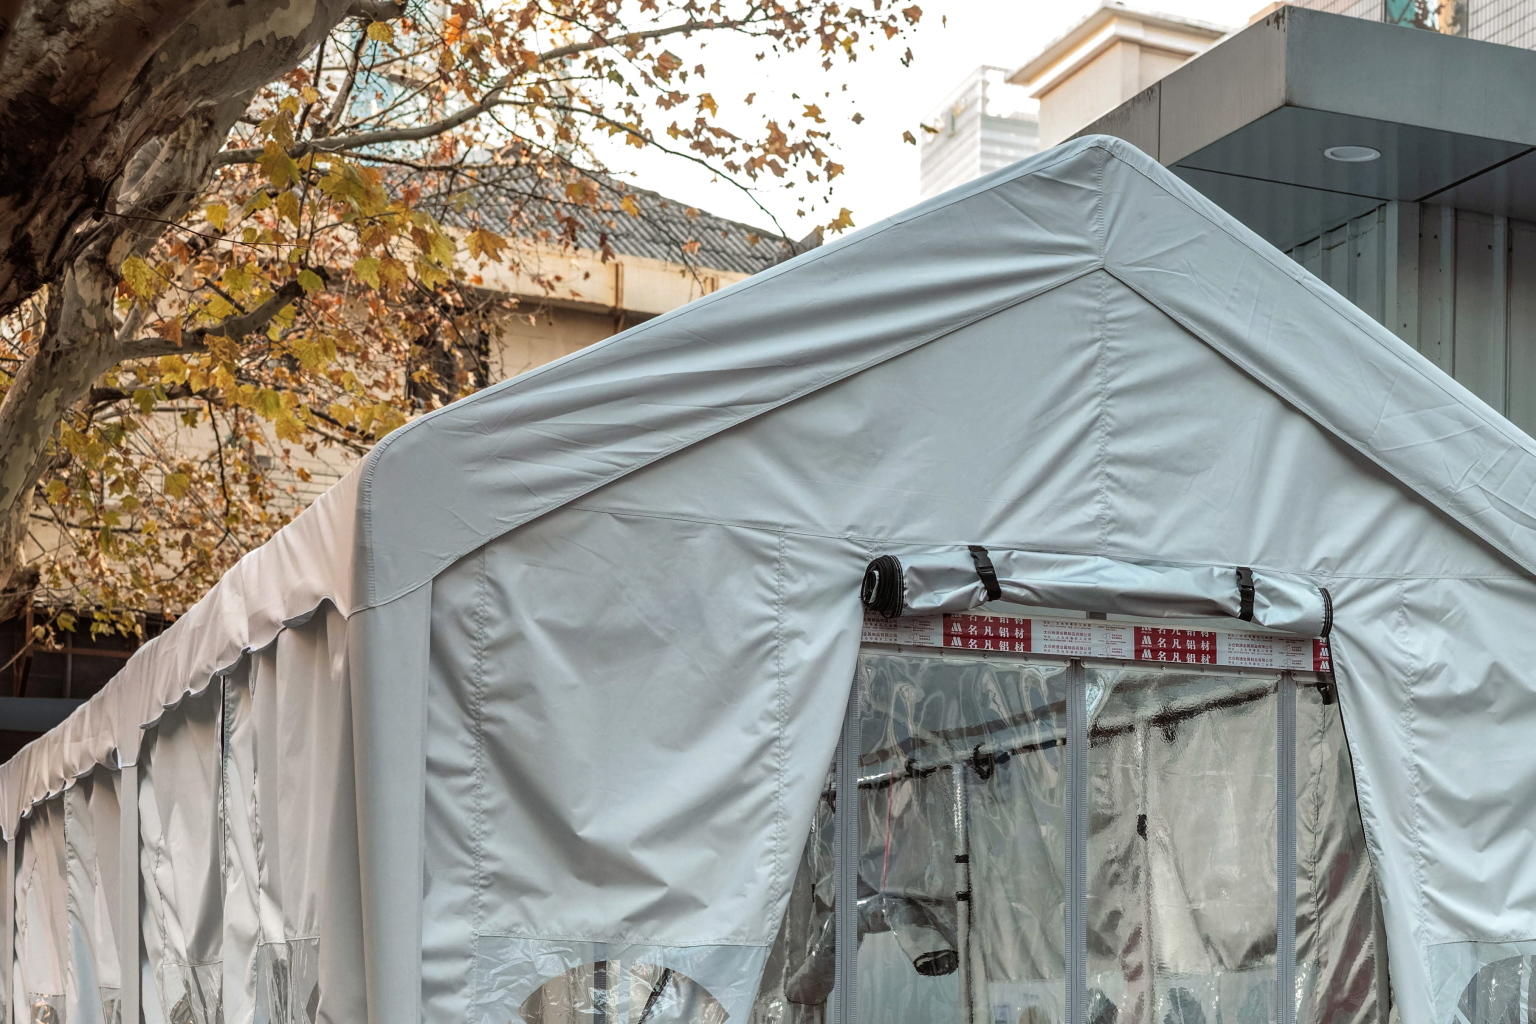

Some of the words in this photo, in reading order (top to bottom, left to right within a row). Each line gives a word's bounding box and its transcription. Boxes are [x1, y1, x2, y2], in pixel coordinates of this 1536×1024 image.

[968, 624, 1025, 639] 名凡铝材
[968, 639, 1025, 653] 名凡铝材
[1157, 637, 1210, 651] 名凡铝材
[1157, 650, 1211, 664] 名凡铝材
